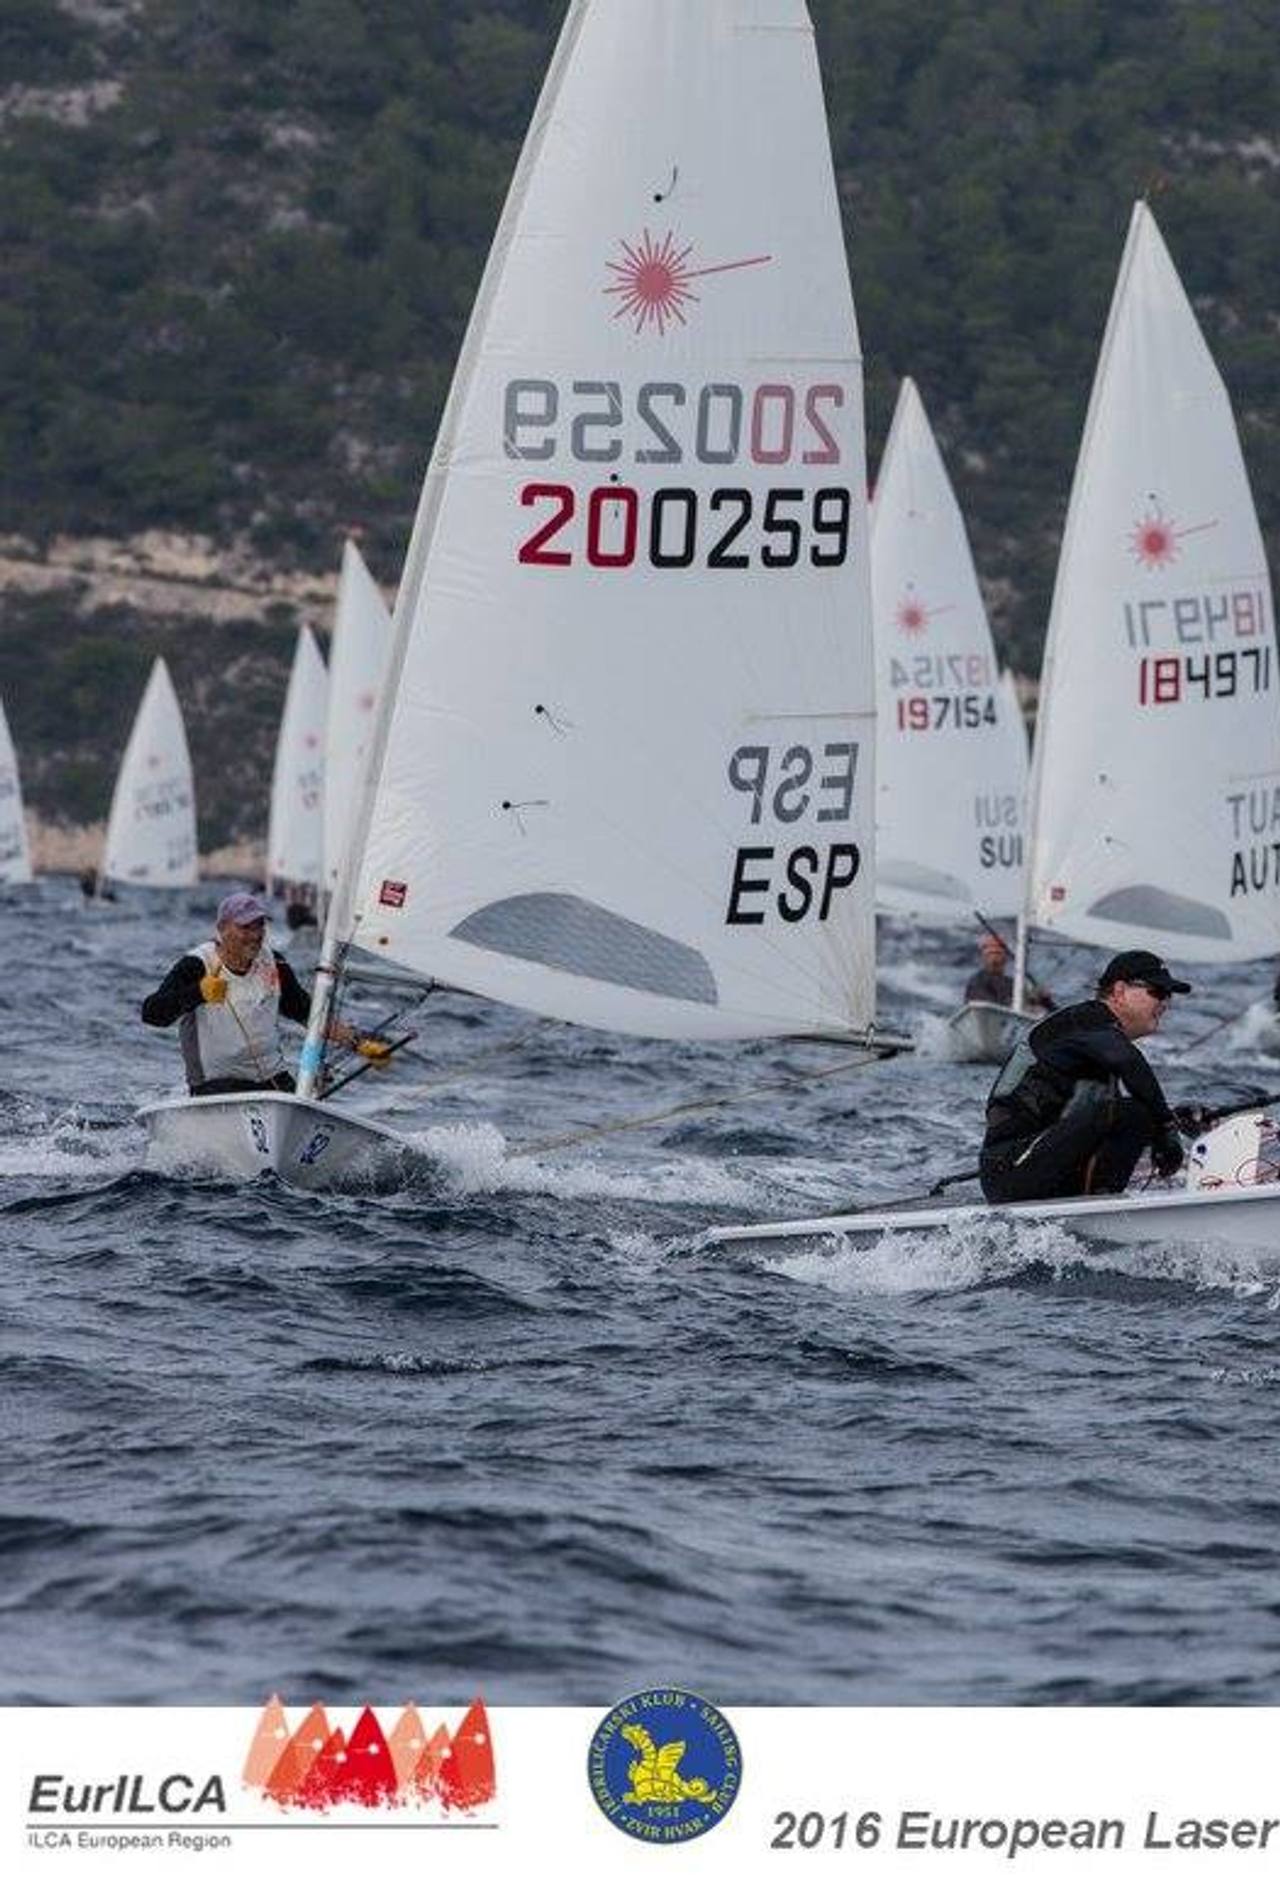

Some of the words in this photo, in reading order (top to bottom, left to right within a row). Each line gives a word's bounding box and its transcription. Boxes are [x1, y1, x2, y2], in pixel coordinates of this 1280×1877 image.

[517, 483, 852, 569] 200259
[1139, 647, 1270, 706] 184971
[897, 696, 998, 731] 197154
[979, 835, 1023, 868] SUI
[724, 843, 861, 926] ESP
